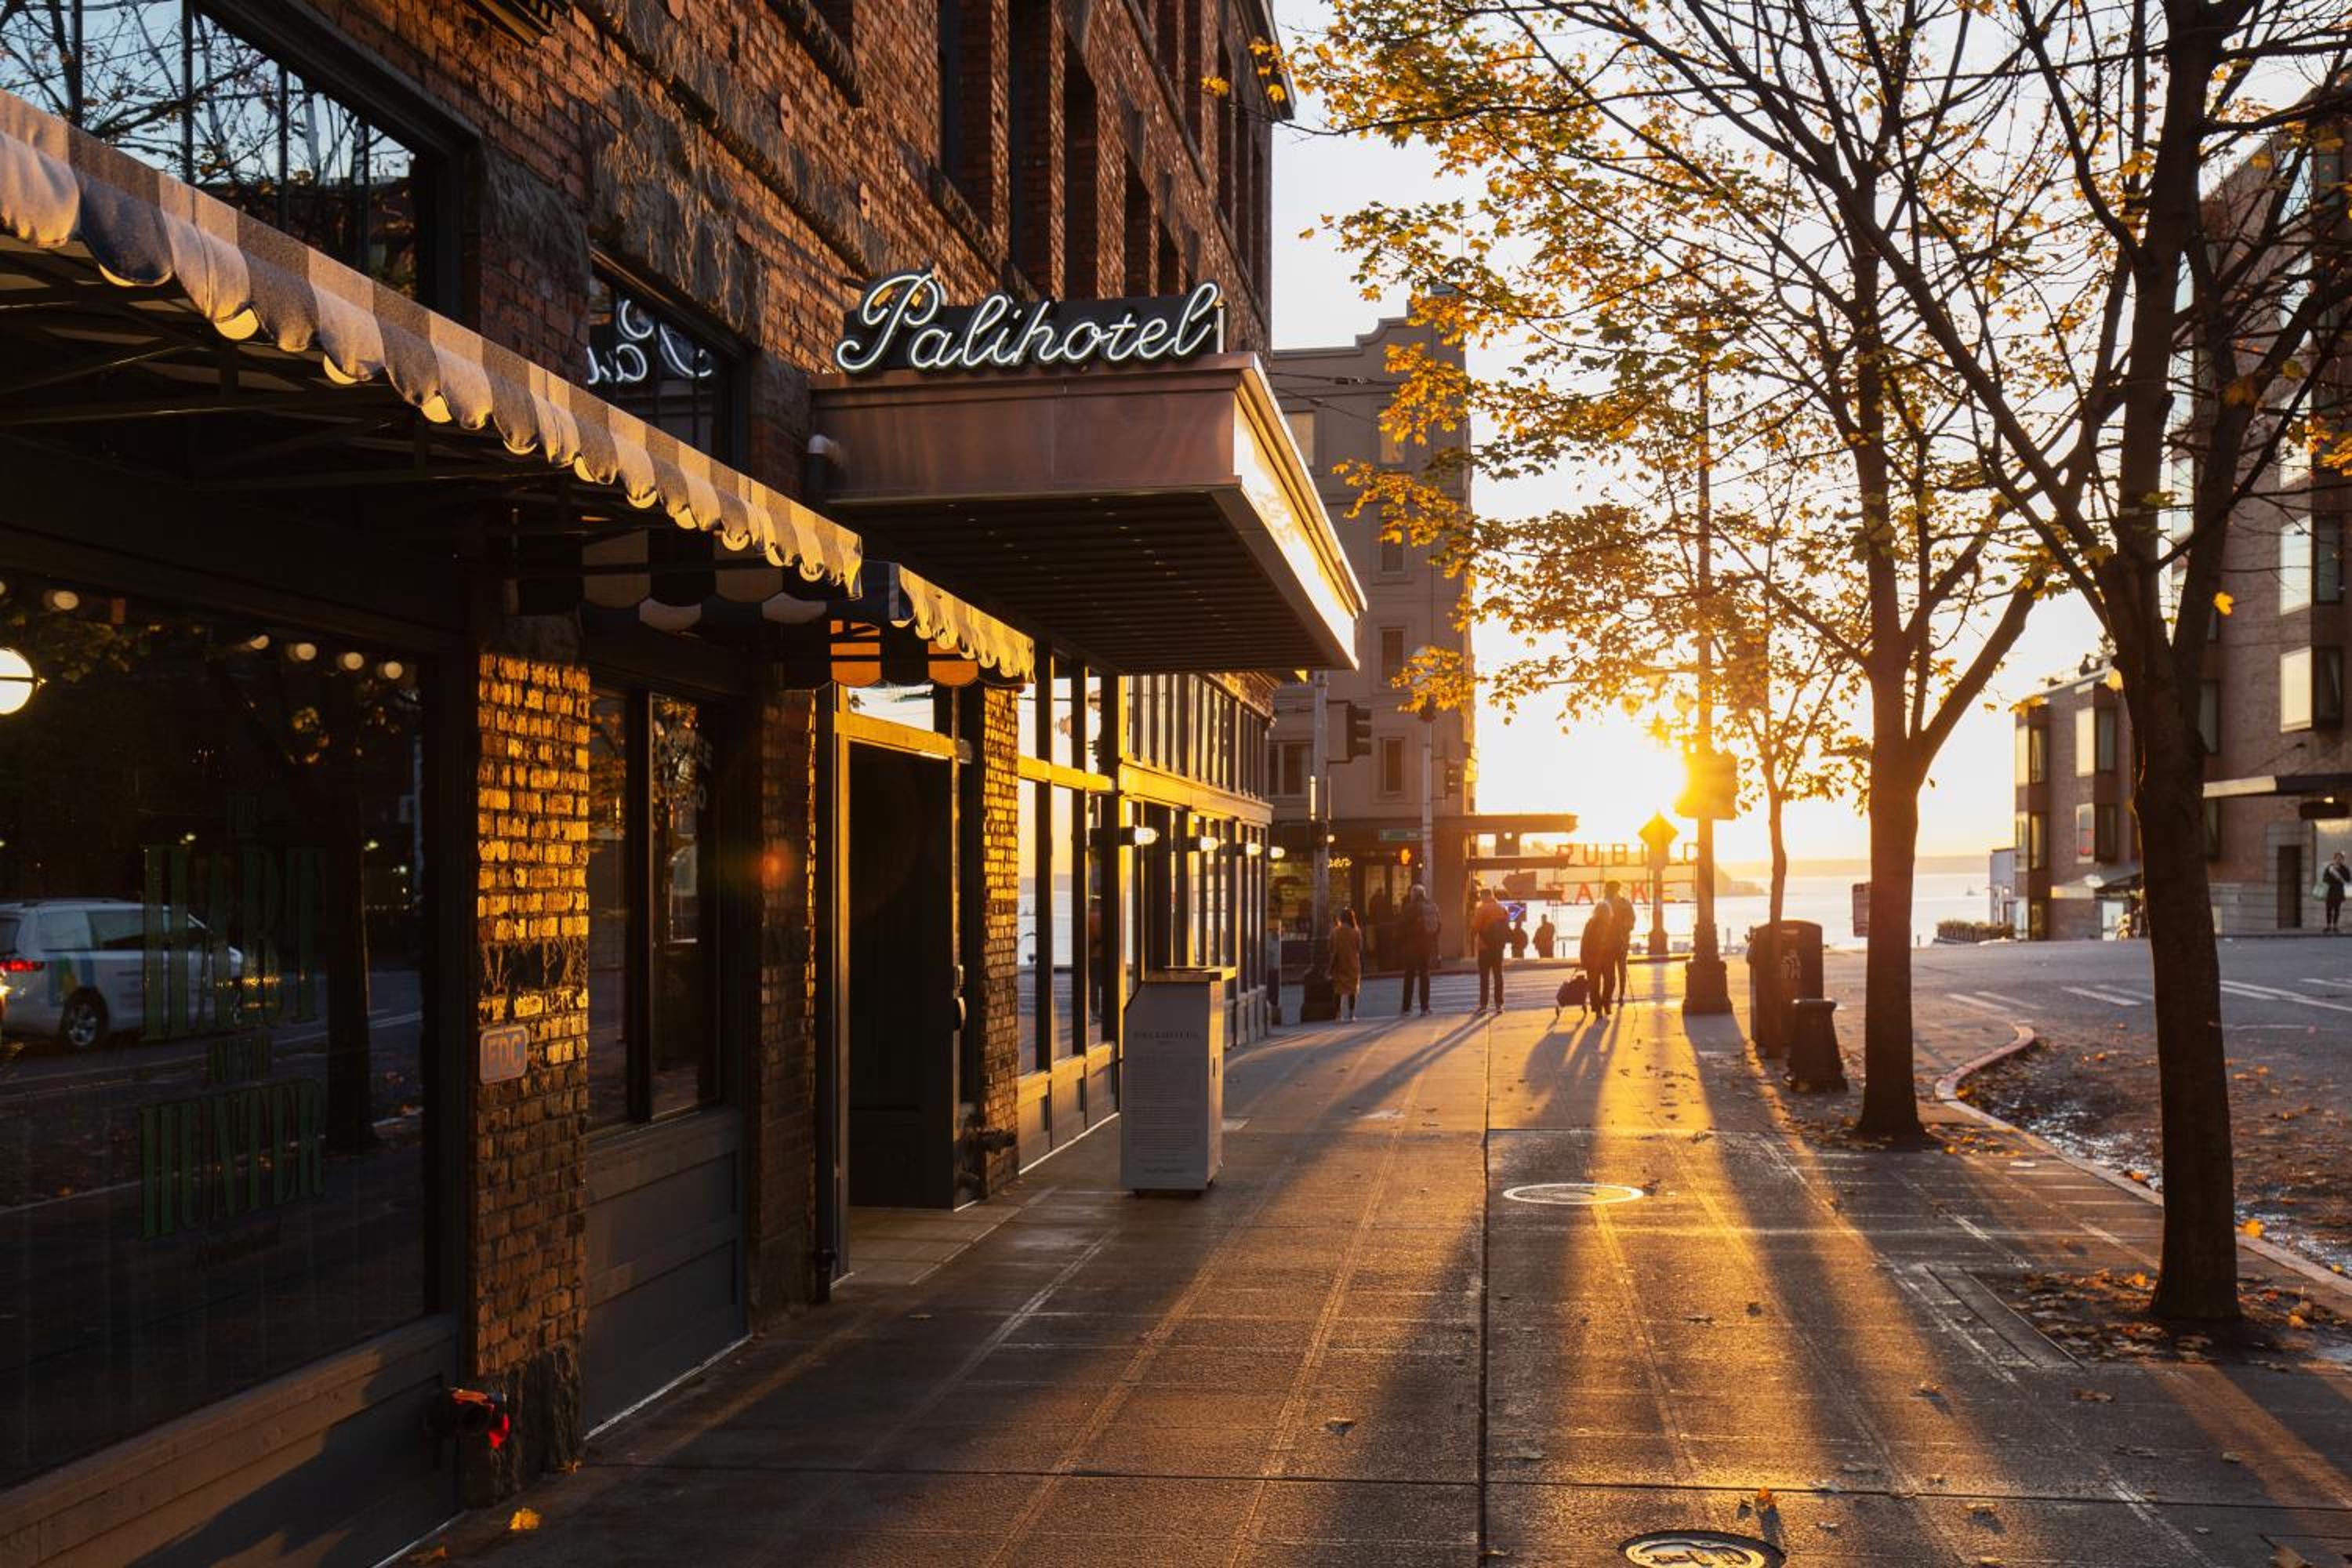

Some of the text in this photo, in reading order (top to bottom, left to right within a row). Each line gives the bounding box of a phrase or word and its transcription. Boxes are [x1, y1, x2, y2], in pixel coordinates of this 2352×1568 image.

[837, 273, 1219, 370] Palihotel
[487, 1035, 522, 1073] FDC
[139, 1080, 326, 1242] HUNTER
